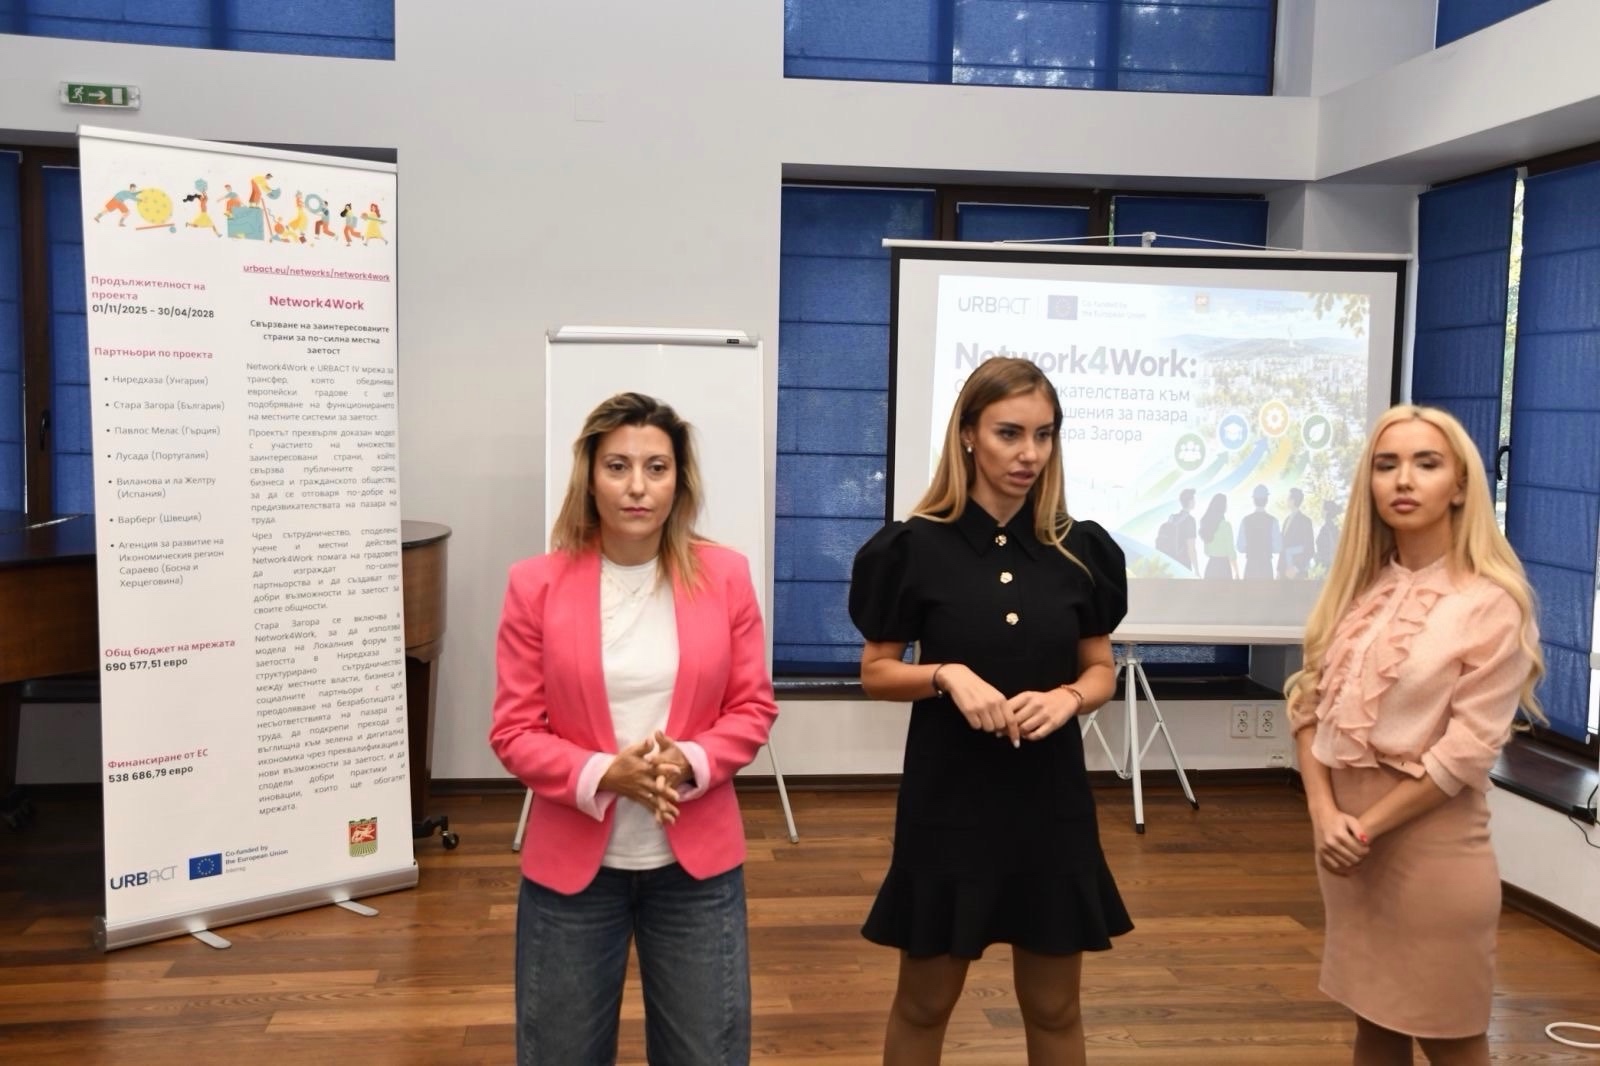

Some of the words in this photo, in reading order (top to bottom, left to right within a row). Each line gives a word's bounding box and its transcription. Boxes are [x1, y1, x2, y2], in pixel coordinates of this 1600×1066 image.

[243, 266, 390, 282] urbact.eu/networks/network4work
[91, 277, 191, 289] Продължителност
[269, 296, 364, 309] Network4Work
[958, 296, 1031, 315] URBACT
[92, 304, 148, 314] 01/11/2025
[158, 307, 214, 318] 30/04/2028
[250, 320, 298, 329] Свързване
[313, 324, 389, 332] заинтересованите
[94, 347, 157, 358] Партньори
[172, 351, 213, 359] проекта
[112, 376, 164, 384] Ниредхаза
[165, 376, 209, 386] (Унгария)
[1159, 389, 1190, 401] към
[113, 401, 142, 410] Стара
[144, 401, 175, 410] Загора
[177, 402, 225, 411] (България)
[1118, 410, 1133, 421] за
[1137, 409, 1188, 424] пазара
[181, 427, 221, 435] (Гърция)
[1091, 426, 1142, 444] Загора
[116, 452, 149, 461] Лусада
[151, 452, 209, 461] (Португалия)
[116, 478, 163, 486] Виланова
[185, 477, 216, 485] Желтру
[117, 489, 166, 499] (Испания)
[117, 516, 156, 524] Варберг
[159, 513, 202, 523] (Швеция)
[172, 539, 212, 548] развитие
[119, 553, 192, 561] Икономическия
[194, 551, 224, 559] регион
[119, 567, 159, 575] Сараево
[161, 564, 191, 573] (Босна
[120, 576, 183, 587] Херцеговина)
[105, 648, 131, 657] Общ
[133, 646, 175, 655] бюджет
[190, 641, 236, 651] мрежата
[105, 662, 126, 671] 690
[129, 659, 161, 670] 577,51
[164, 659, 188, 667] евро
[108, 754, 182, 768] Финансиране
[197, 748, 208, 757] ЕС
[108, 773, 129, 782] 538
[131, 768, 167, 780] 686,79
[169, 767, 193, 775] евро
[225, 846, 259, 857] Co-funded
[260, 845, 268, 853] by
[237, 852, 269, 864] European
[269, 849, 289, 857] Union
[110, 865, 178, 890] URBACT
